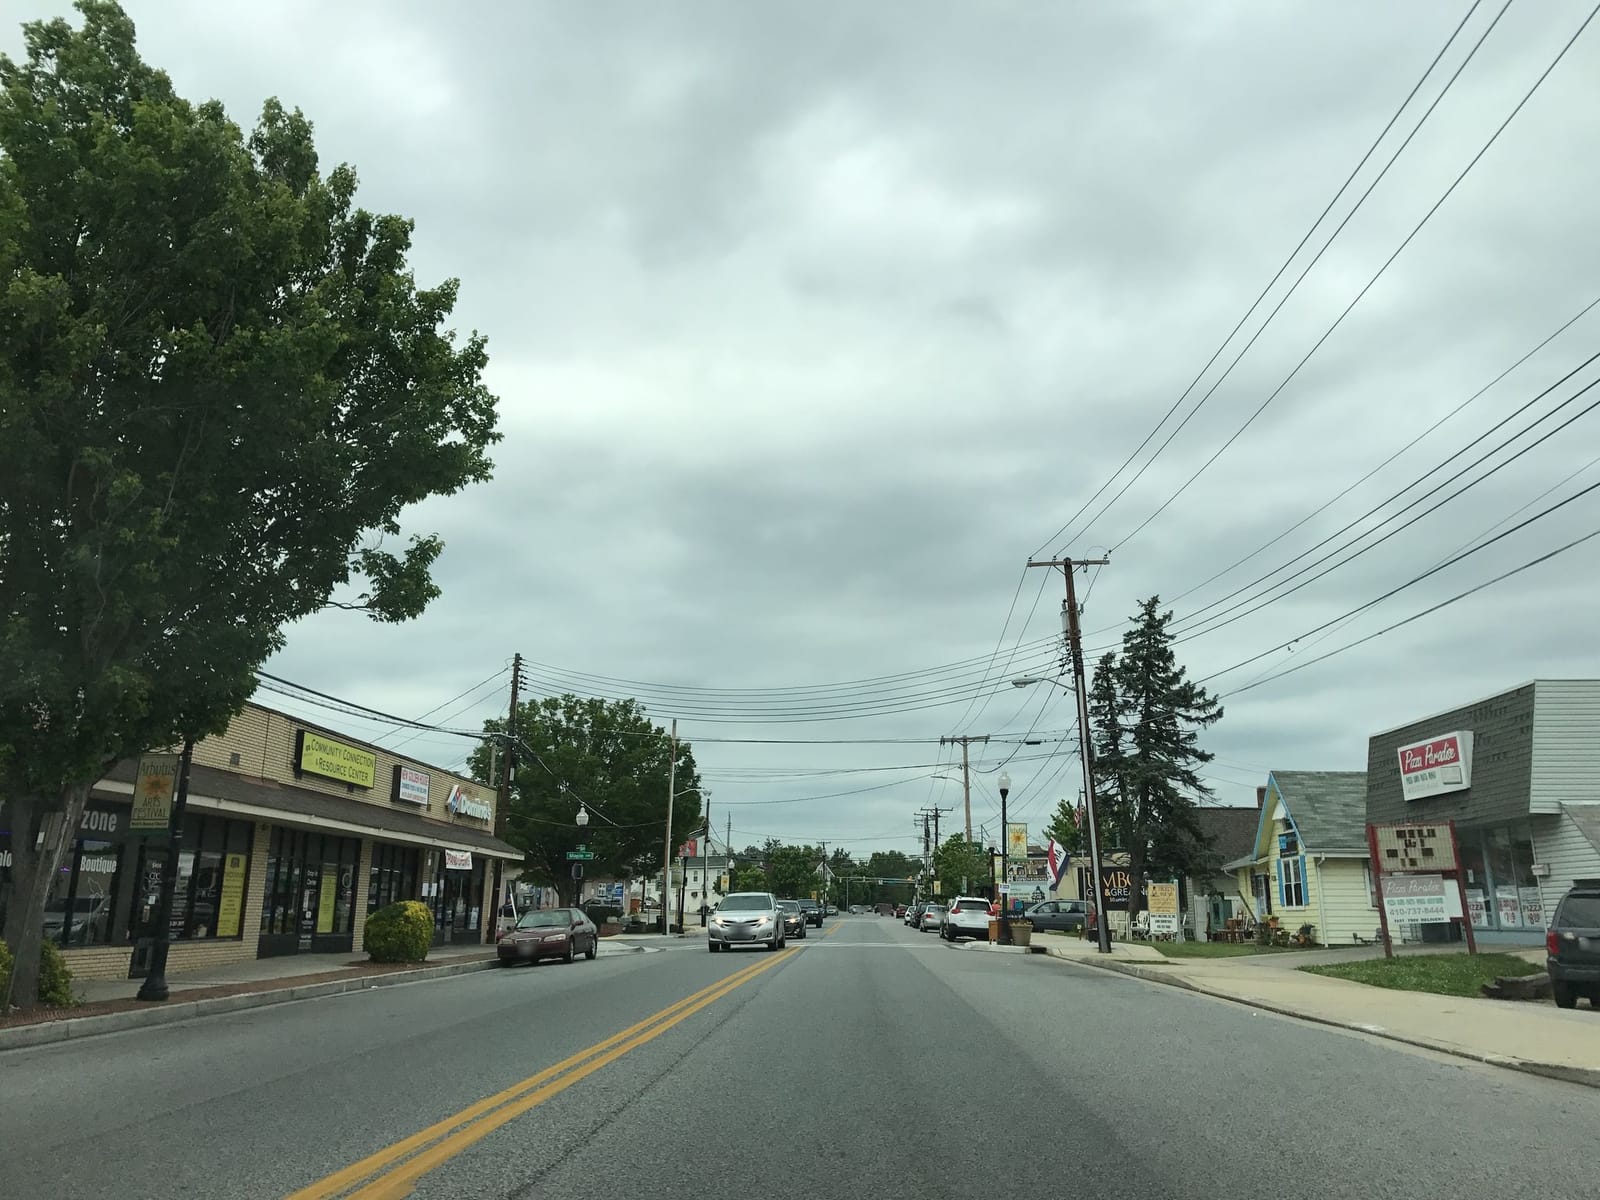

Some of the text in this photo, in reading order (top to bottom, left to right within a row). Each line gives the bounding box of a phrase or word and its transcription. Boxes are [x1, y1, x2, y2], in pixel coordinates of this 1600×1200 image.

[311, 739, 342, 758] COMMUNITY
[343, 749, 374, 768] CONNECTION
[1405, 750, 1423, 771] Pizza
[319, 757, 346, 776] RESOURCE
[348, 766, 369, 782] CENTER
[133, 807, 168, 818] FESTIVAL
[80, 856, 117, 874] Boutique
